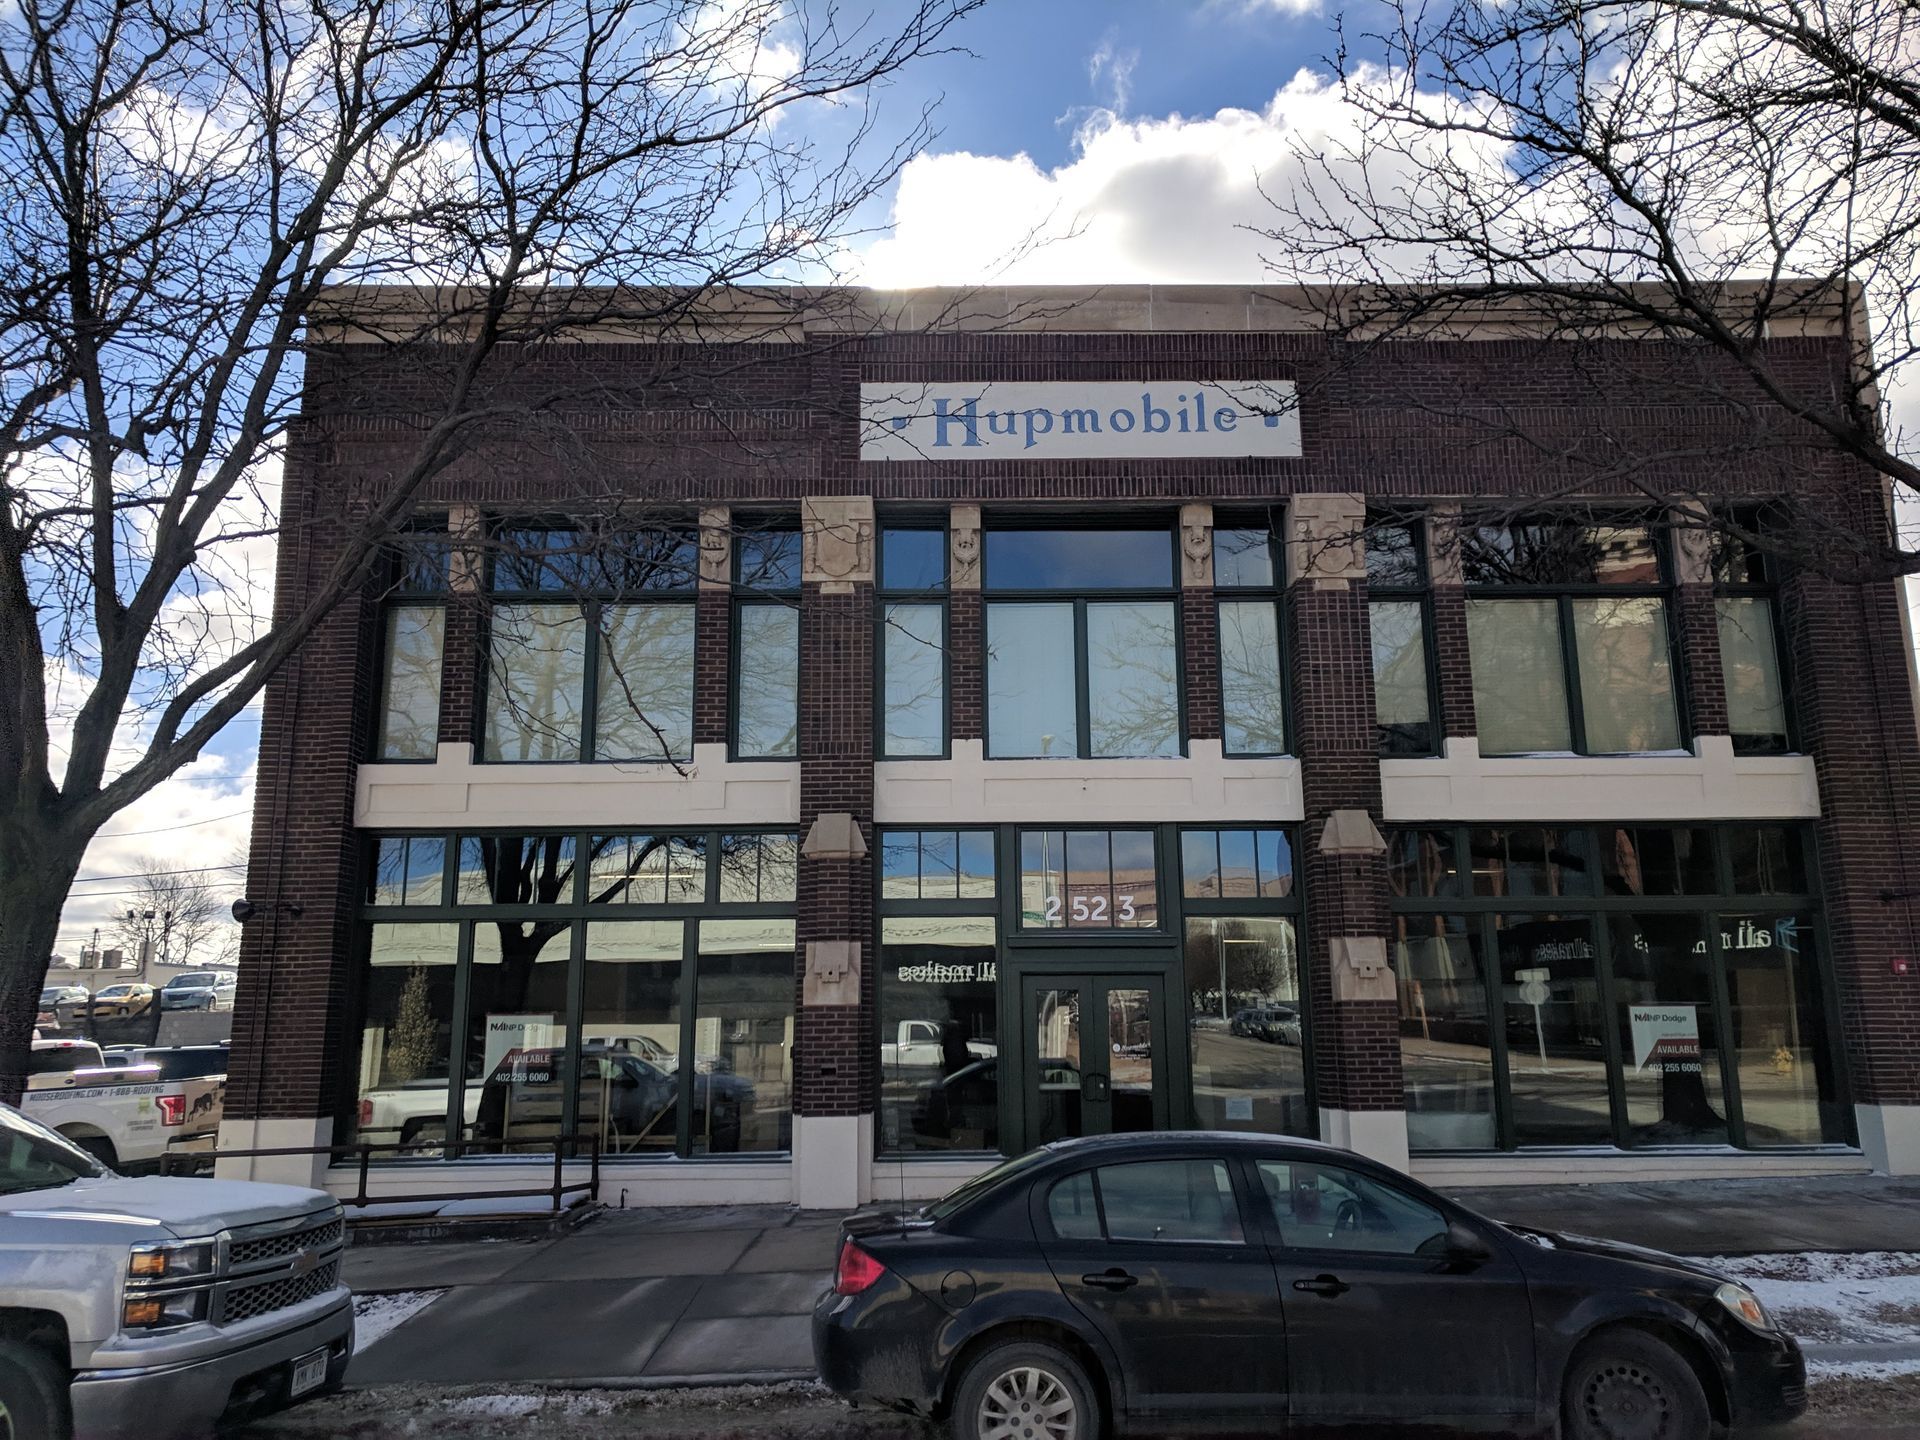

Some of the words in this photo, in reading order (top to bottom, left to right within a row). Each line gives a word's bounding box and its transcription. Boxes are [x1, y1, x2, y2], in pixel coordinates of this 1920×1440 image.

[931, 392, 1237, 449] Hupmobile
[1045, 895, 1136, 921] 2523
[1662, 1014, 1687, 1023] Dodge
[1657, 1044, 1700, 1054] AVAILABLE
[507, 1054, 550, 1064] AVAILABLE
[1648, 1063, 1663, 1072] 402
[1665, 1063, 1680, 1072] 255
[496, 1072, 511, 1082] 402
[512, 1072, 527, 1082] 255
[529, 1072, 549, 1082] 6060
